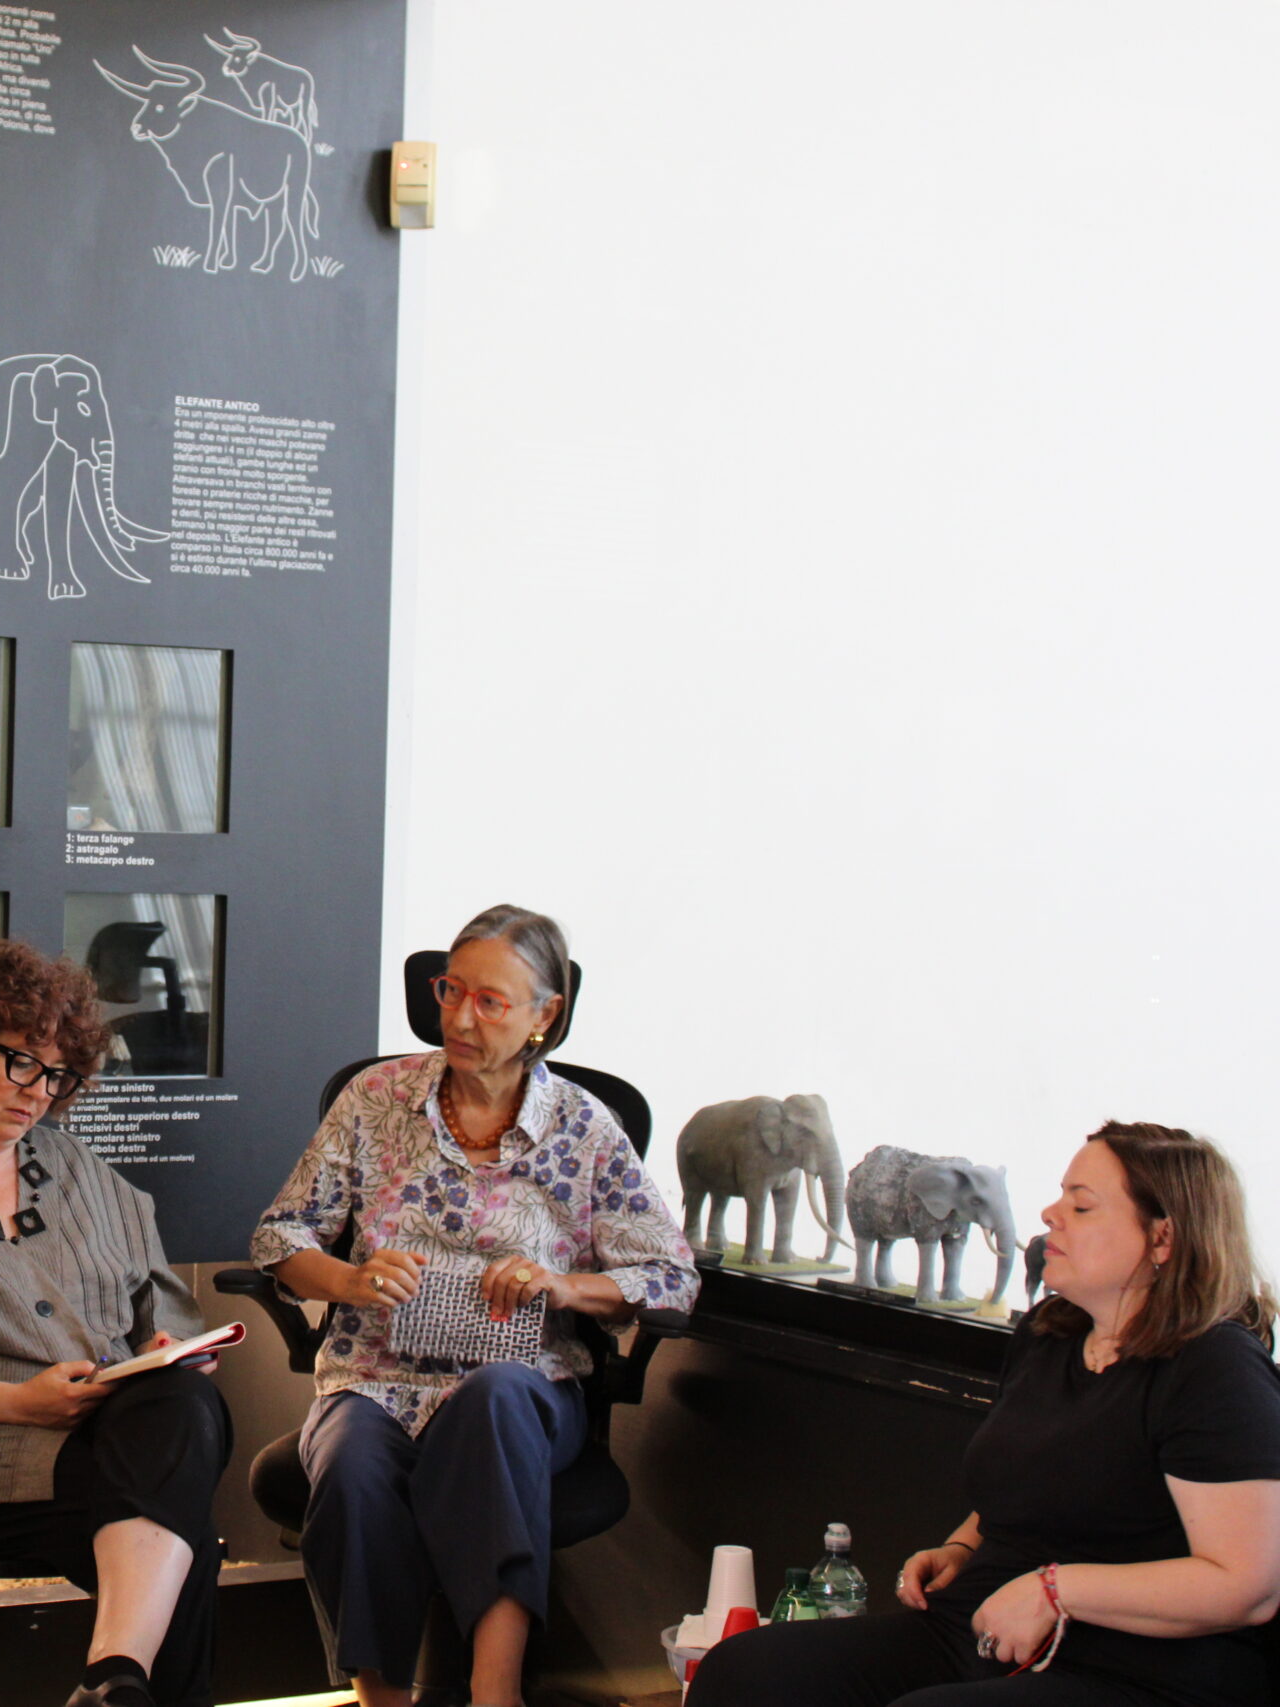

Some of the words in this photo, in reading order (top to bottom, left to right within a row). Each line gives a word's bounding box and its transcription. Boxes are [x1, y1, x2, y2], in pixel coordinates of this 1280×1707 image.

[175, 396, 223, 409] ELEFANTE
[224, 401, 260, 412] ANTICO
[67, 833, 74, 842] 1:
[77, 834, 99, 843] terza
[101, 834, 135, 846] falange
[66, 844, 74, 853] 2:
[77, 844, 119, 856] astragalo
[66, 855, 74, 864] 3:
[76, 855, 124, 867] metacarpo
[126, 856, 155, 866] destro
